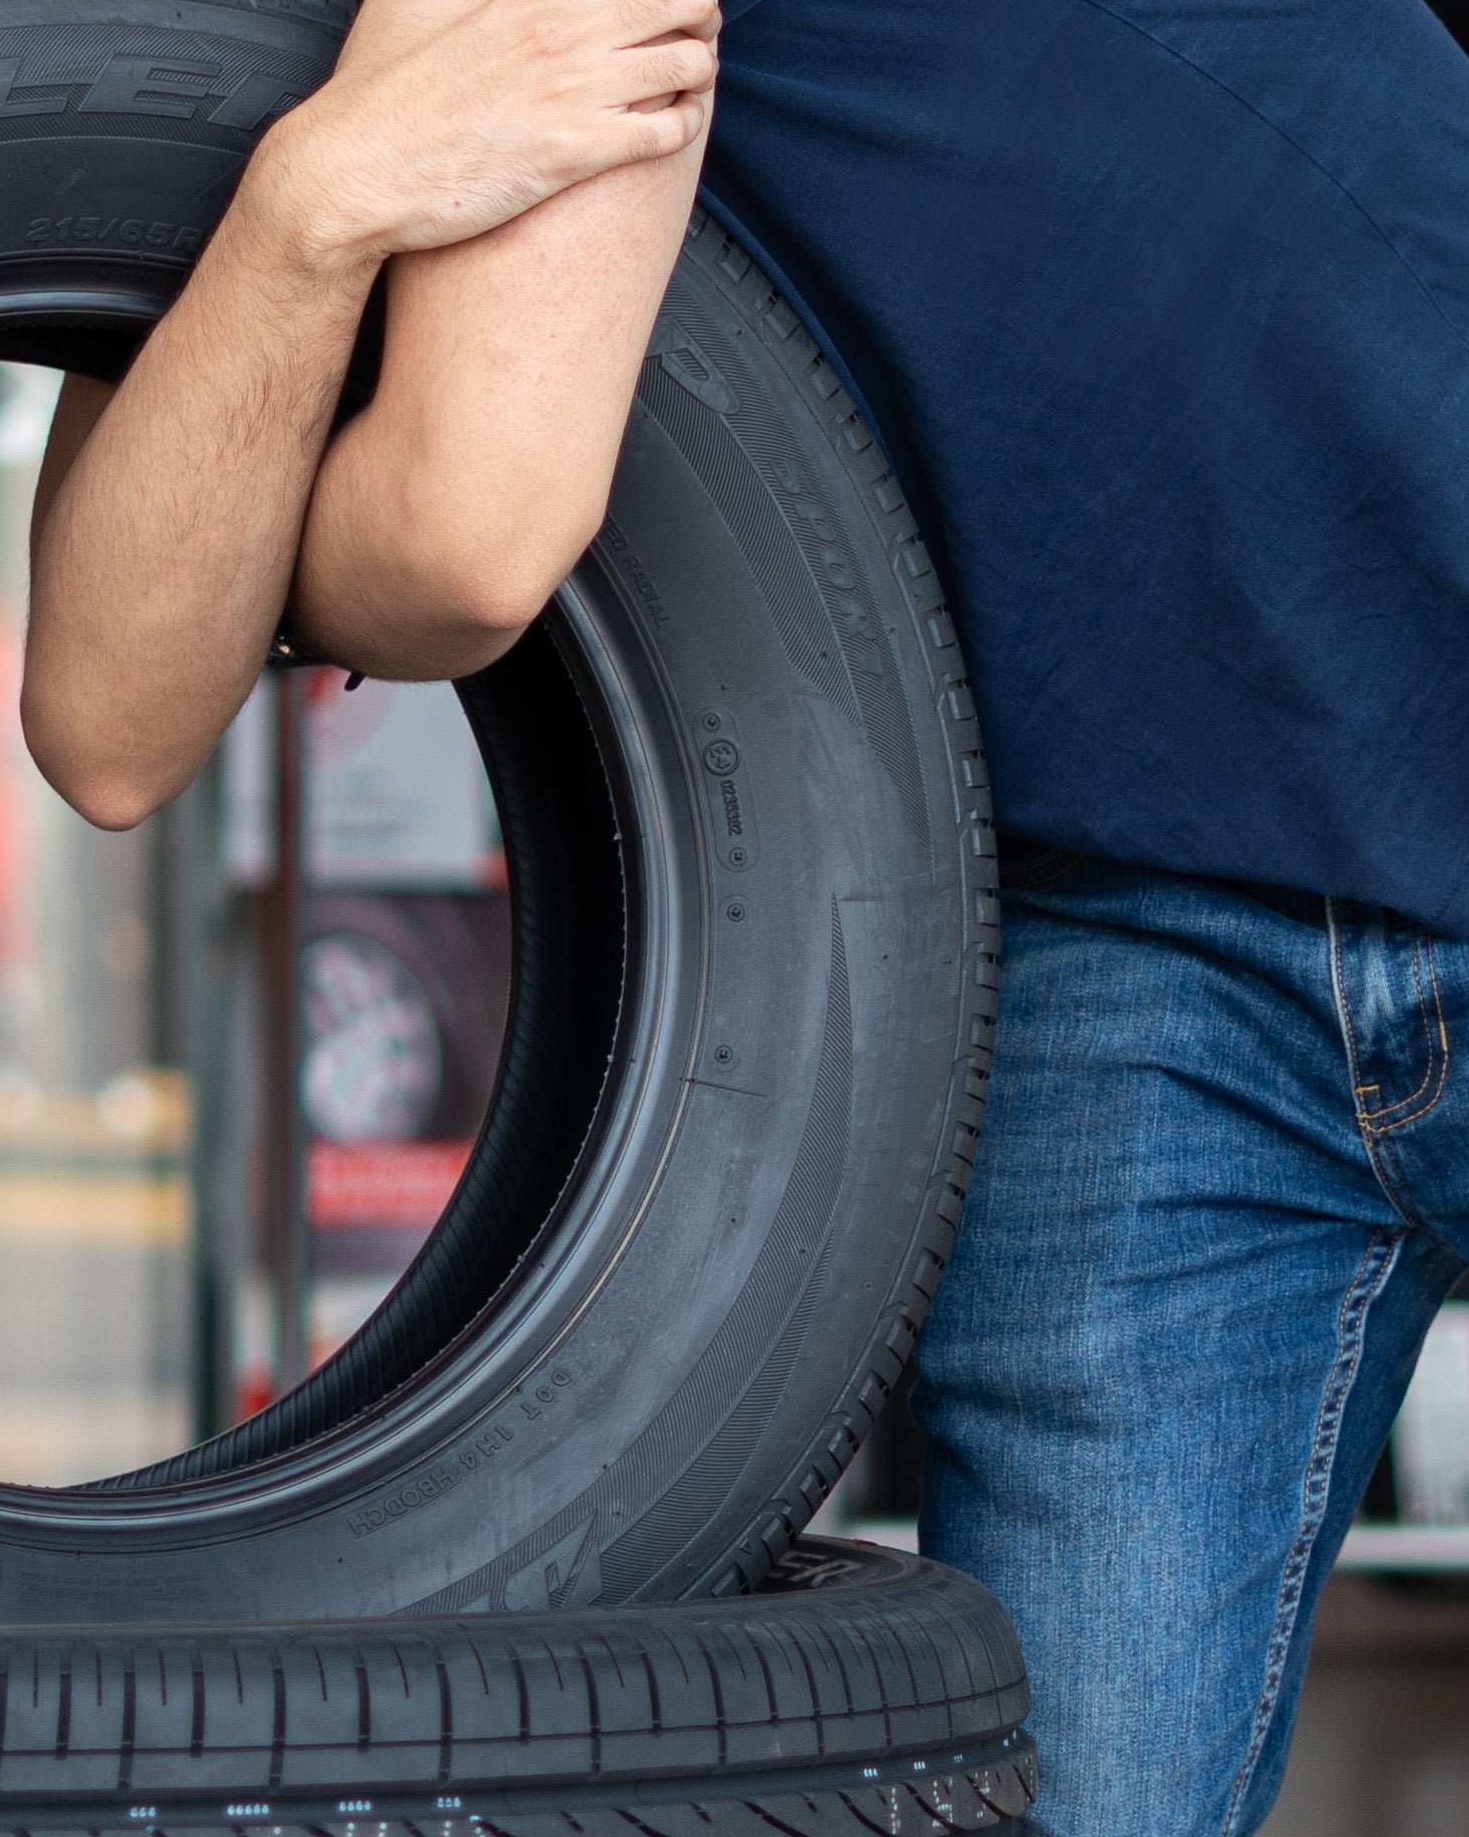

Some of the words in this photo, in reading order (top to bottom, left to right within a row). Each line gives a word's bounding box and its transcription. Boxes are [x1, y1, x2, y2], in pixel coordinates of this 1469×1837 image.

[26, 216, 206, 252] 215/65R
[768, 457, 888, 683] SPORT
[519, 1368, 572, 1422] DOT
